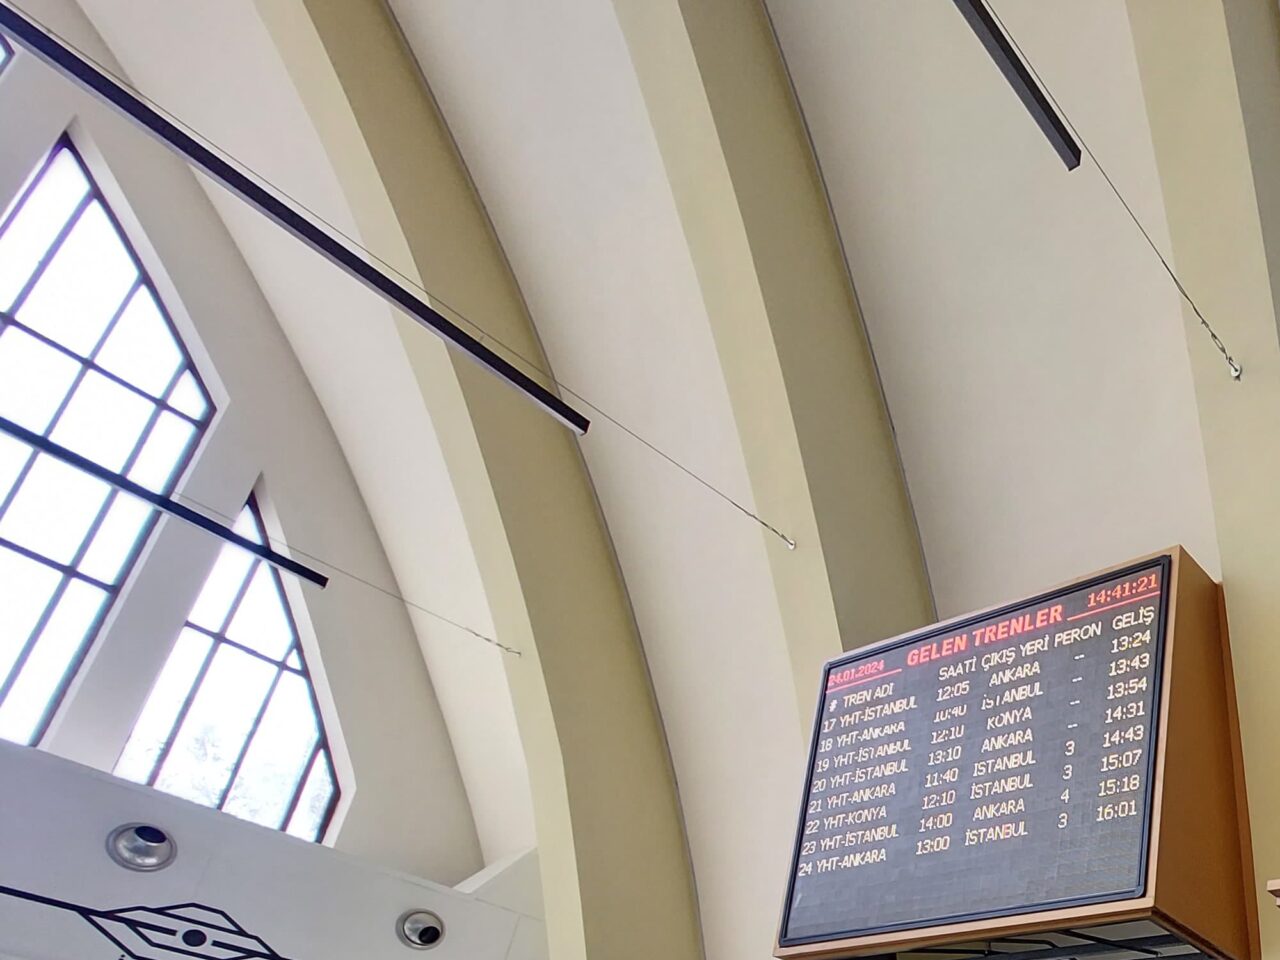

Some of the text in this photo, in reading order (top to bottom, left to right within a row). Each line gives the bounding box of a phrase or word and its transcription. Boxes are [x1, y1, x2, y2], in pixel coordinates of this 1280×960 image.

[843, 688, 871, 708] TREN
[873, 682, 895, 702] ADI
[938, 656, 977, 680] SAATİ
[981, 647, 1015, 671] ÇIKIŞ
[1019, 634, 1049, 657] YERİ
[1054, 621, 1102, 647] PERON
[1112, 606, 1155, 630] GELİŞ
[907, 634, 968, 666] GELEN
[972, 604, 1063, 646] TRENLER
[1088, 574, 1158, 607] 14:41:21
[816, 759, 830, 773] 19
[986, 706, 1032, 730] KONYA
[1106, 677, 1148, 700] 13:54
[819, 740, 833, 753] 18
[836, 721, 905, 748] YHT-ANKARA
[1108, 653, 1150, 676] 13:43
[823, 718, 836, 733] 17
[936, 681, 970, 702] 12:05
[989, 661, 1041, 687] ANKARA
[1111, 630, 1151, 653] 13:24
[805, 821, 819, 835] 22
[823, 805, 887, 831] YHT-KONYA
[921, 790, 955, 810] 12:10
[1062, 765, 1073, 780] 3
[1100, 749, 1142, 771] 15:07
[809, 802, 822, 814] 21
[827, 782, 896, 810] YHT-ANKARA
[924, 768, 959, 788] 11:40
[1064, 740, 1076, 756] 3
[1102, 725, 1144, 748] 14:43
[812, 779, 826, 793] 20
[927, 746, 961, 766] 13:10
[981, 728, 1033, 753] ANKARA
[1105, 701, 1145, 723] 14:31
[798, 863, 812, 877] 24
[816, 848, 887, 873] YHT-ANKARA
[915, 836, 950, 855] 13:00
[1058, 813, 1068, 829] 3
[1096, 800, 1137, 822] 16:01
[801, 842, 817, 855] 23
[918, 813, 953, 832] 14:00
[972, 798, 1025, 822] ANKARA
[1060, 788, 1069, 803] 4
[1098, 774, 1140, 797] 15:18
